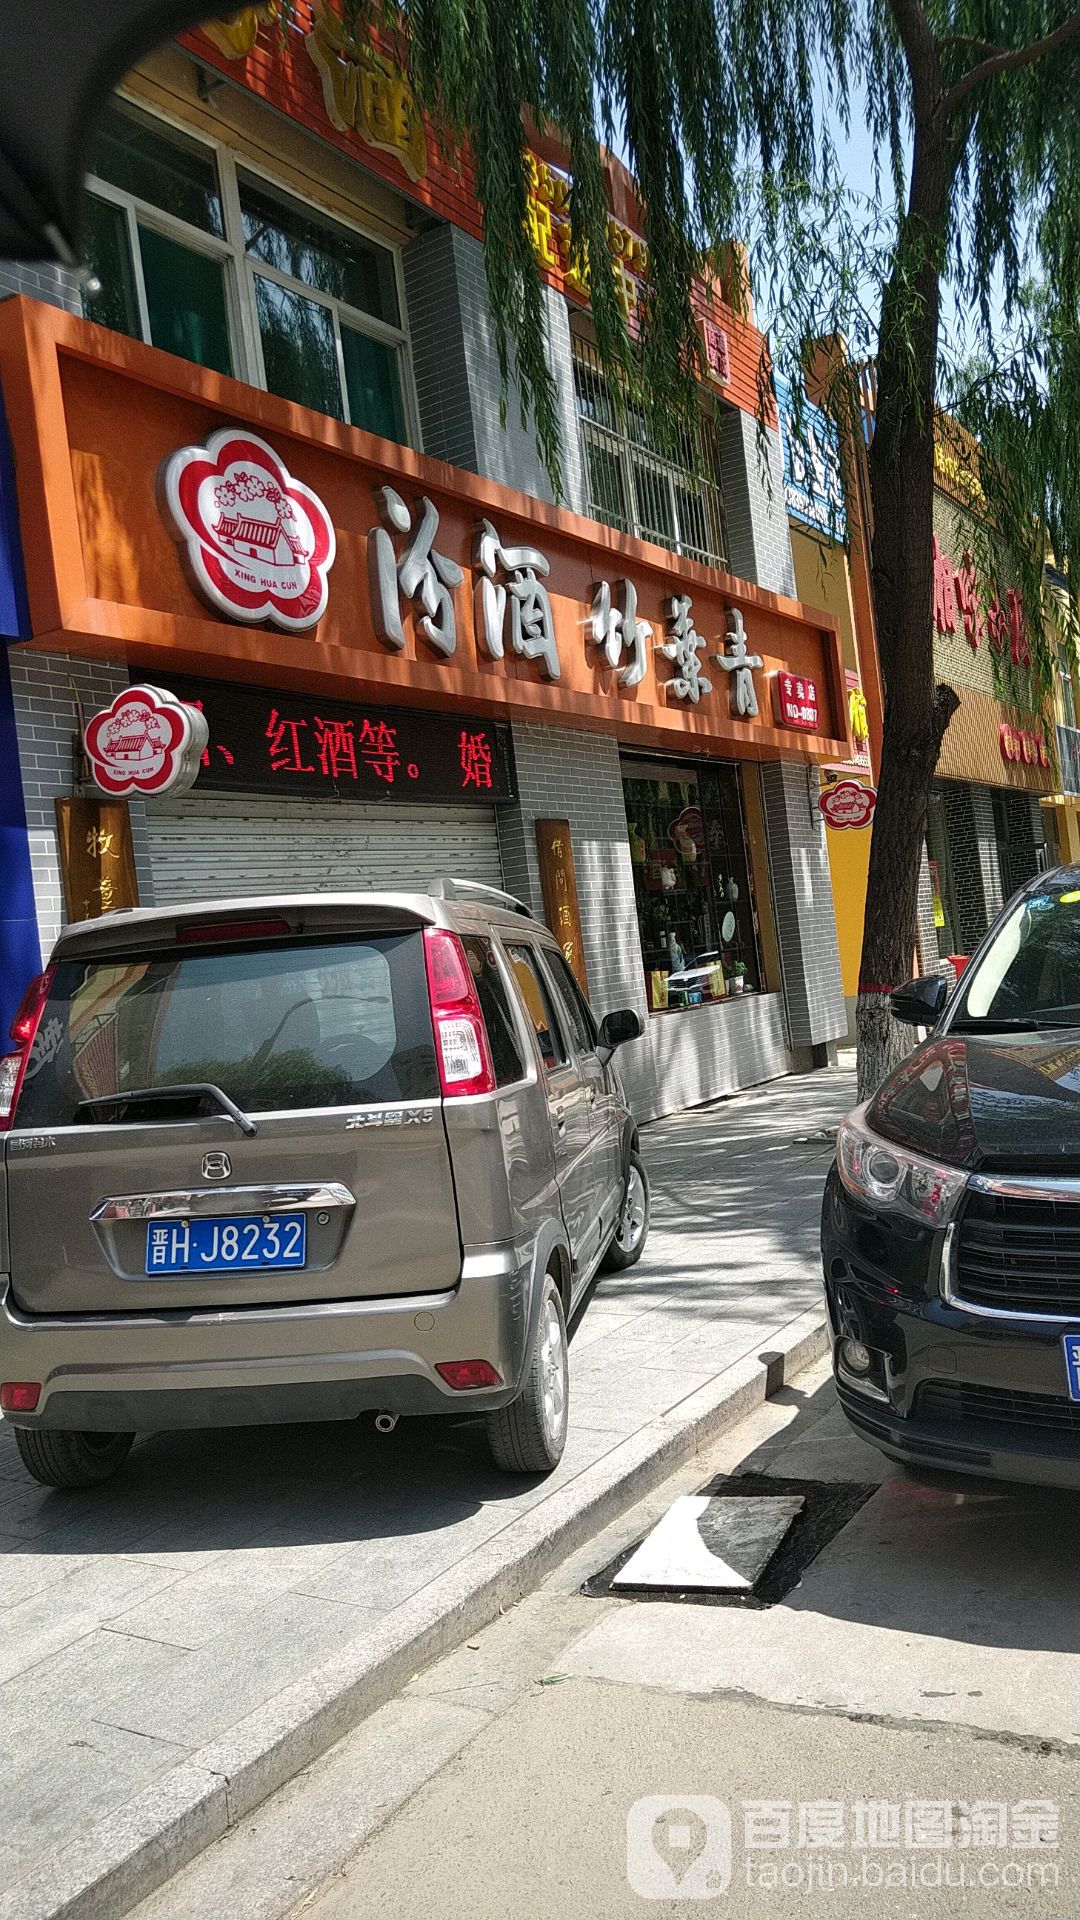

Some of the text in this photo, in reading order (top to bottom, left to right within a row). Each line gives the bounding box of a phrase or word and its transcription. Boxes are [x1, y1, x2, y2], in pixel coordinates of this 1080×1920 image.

[234, 568, 298, 590] XING HUA CUN
[784, 678, 816, 702] 专卖店
[457, 731, 494, 789] 婚
